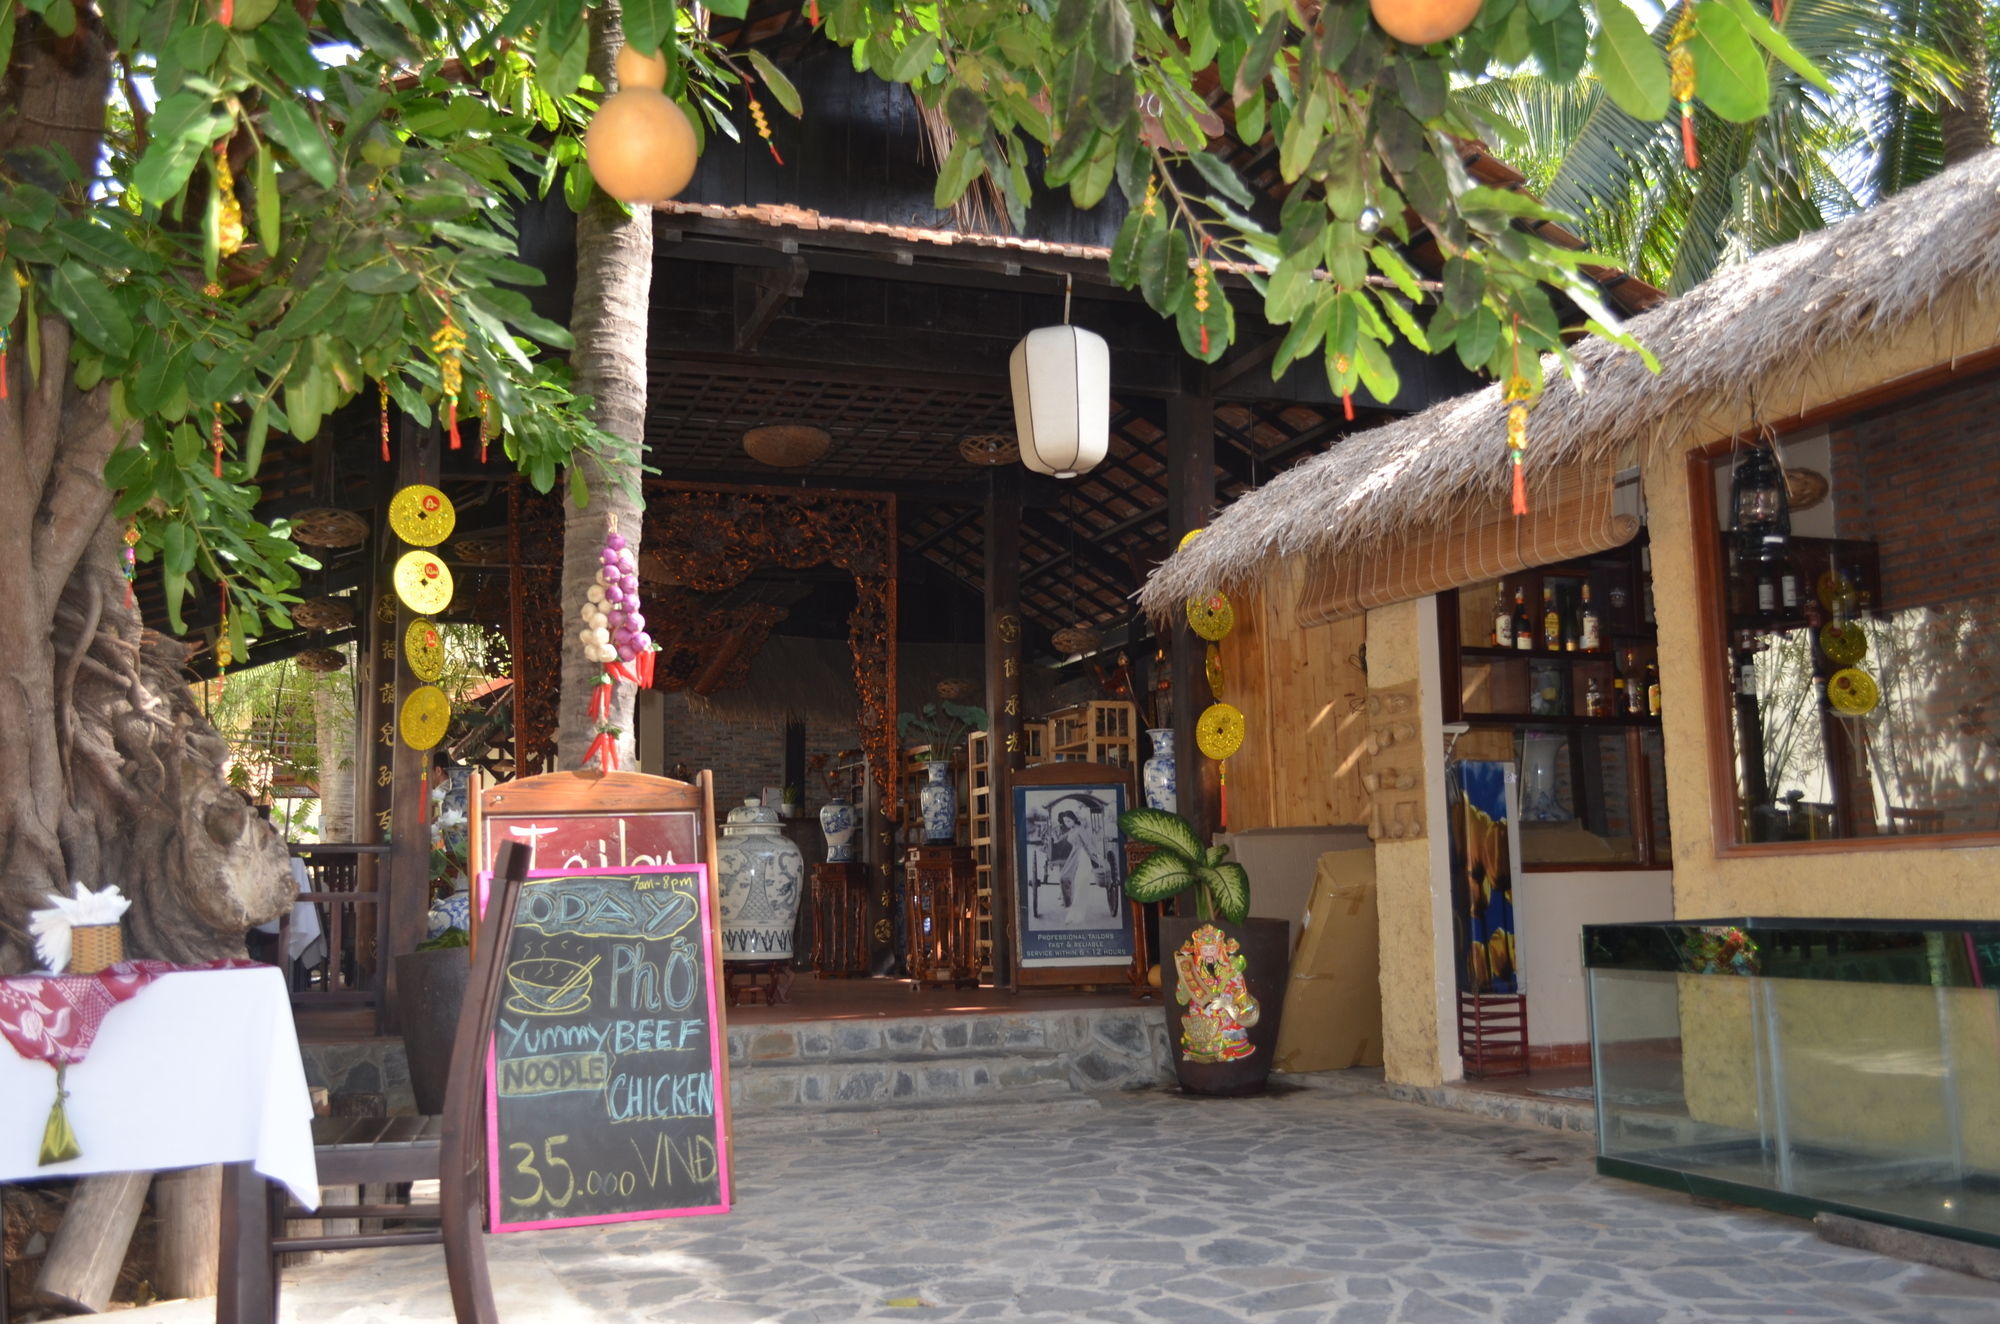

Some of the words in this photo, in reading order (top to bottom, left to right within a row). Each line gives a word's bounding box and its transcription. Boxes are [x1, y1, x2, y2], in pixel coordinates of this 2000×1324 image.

[523, 888, 687, 936] ODAY
[500, 1018, 612, 1056] Yummy
[615, 1018, 704, 1054] BEEF
[503, 1056, 607, 1090] NOODLE
[609, 1070, 713, 1120] CHICKEN
[509, 1134, 636, 1208] 35.000
